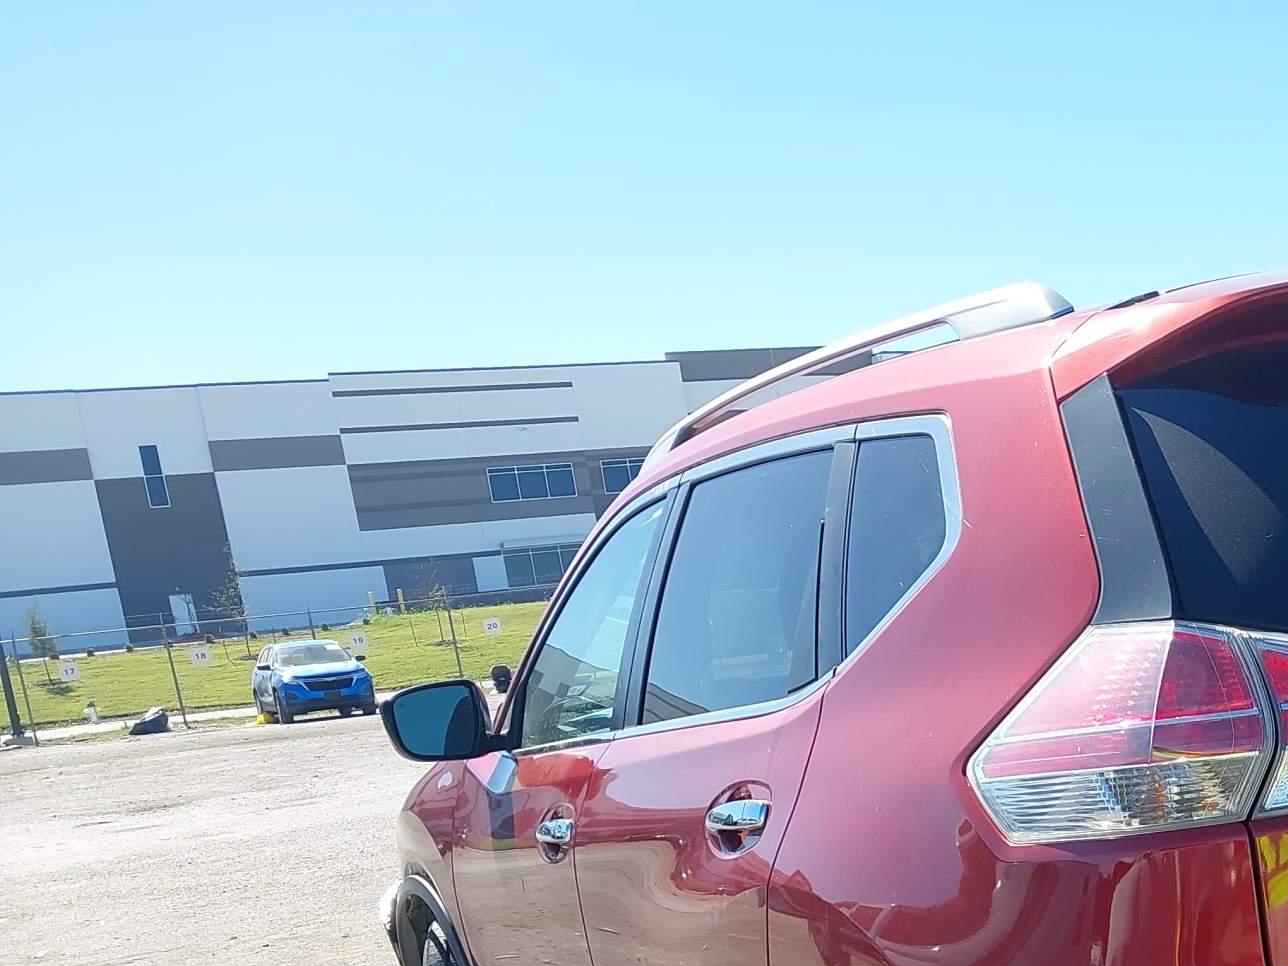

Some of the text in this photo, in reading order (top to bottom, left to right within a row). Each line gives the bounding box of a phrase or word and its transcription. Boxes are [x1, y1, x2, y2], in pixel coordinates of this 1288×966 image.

[486, 622, 498, 630] 20
[352, 636, 364, 644] 19
[195, 652, 207, 660] 18
[63, 667, 75, 676] 17
